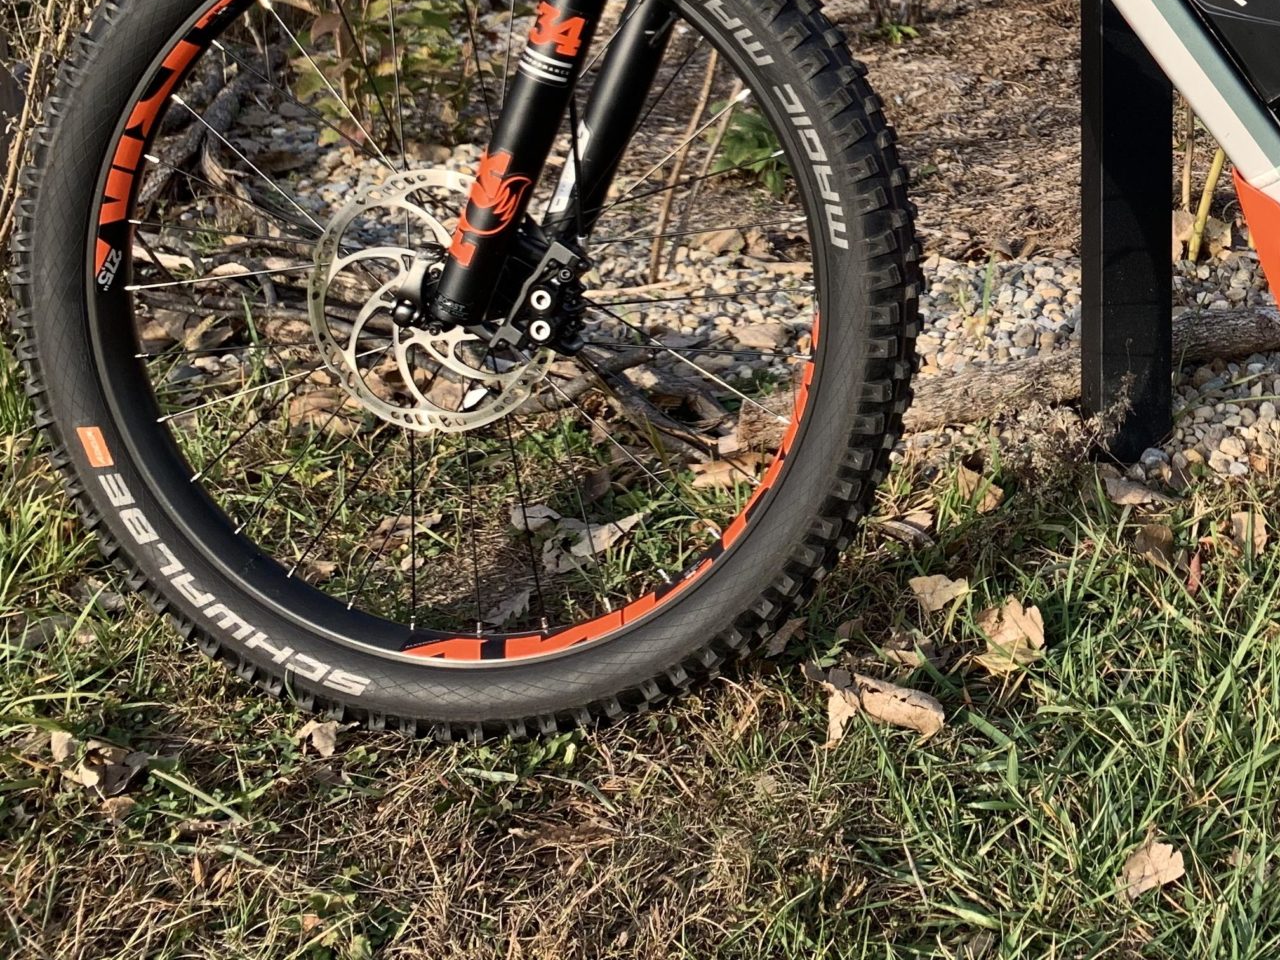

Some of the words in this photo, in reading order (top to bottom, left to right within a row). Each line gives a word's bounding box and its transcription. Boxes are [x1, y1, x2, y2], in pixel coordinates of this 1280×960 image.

[529, 1, 585, 57] 34
[773, 83, 849, 250] MAGIC
[98, 473, 371, 696] SCHWALBE
